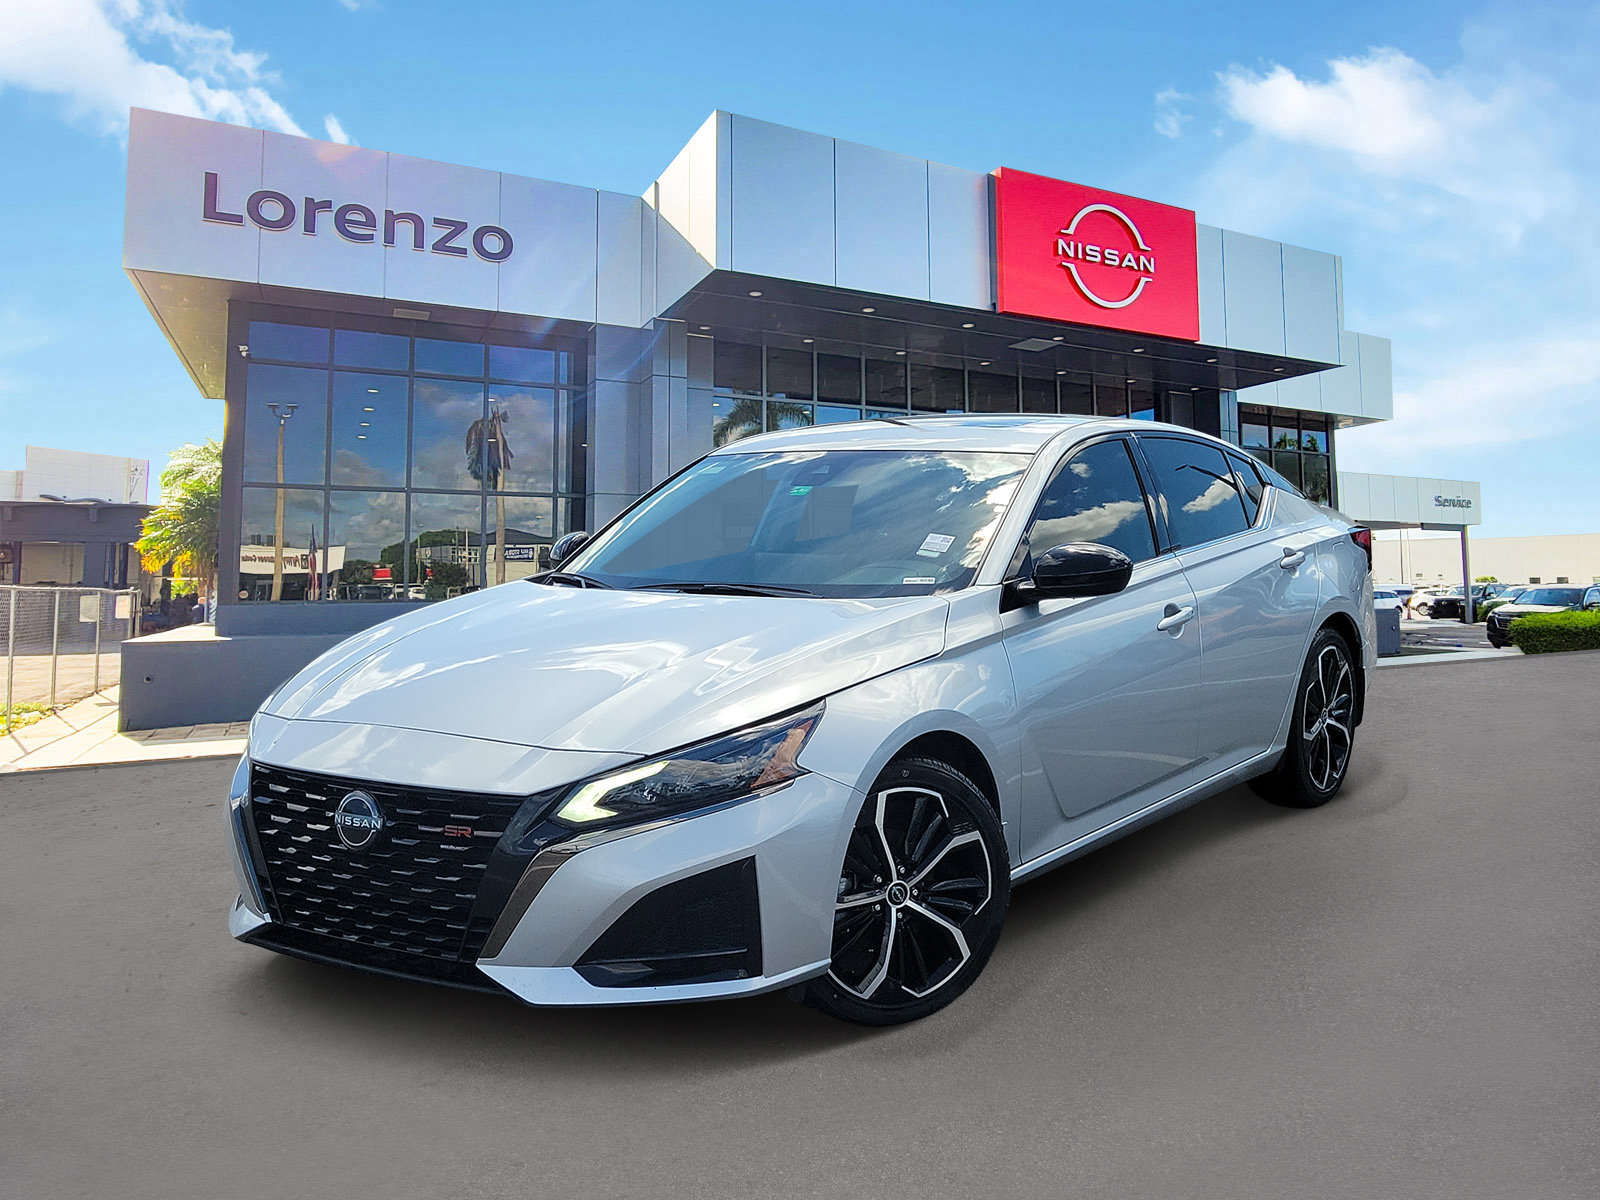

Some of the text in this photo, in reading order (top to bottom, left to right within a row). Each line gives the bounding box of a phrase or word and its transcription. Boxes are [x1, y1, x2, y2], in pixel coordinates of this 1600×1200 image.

[202, 171, 515, 263] Lorenzo
[1057, 238, 1155, 273] NISSAN
[1434, 495, 1472, 508] Service
[334, 812, 382, 829] NISSAN
[444, 824, 472, 838] SR
